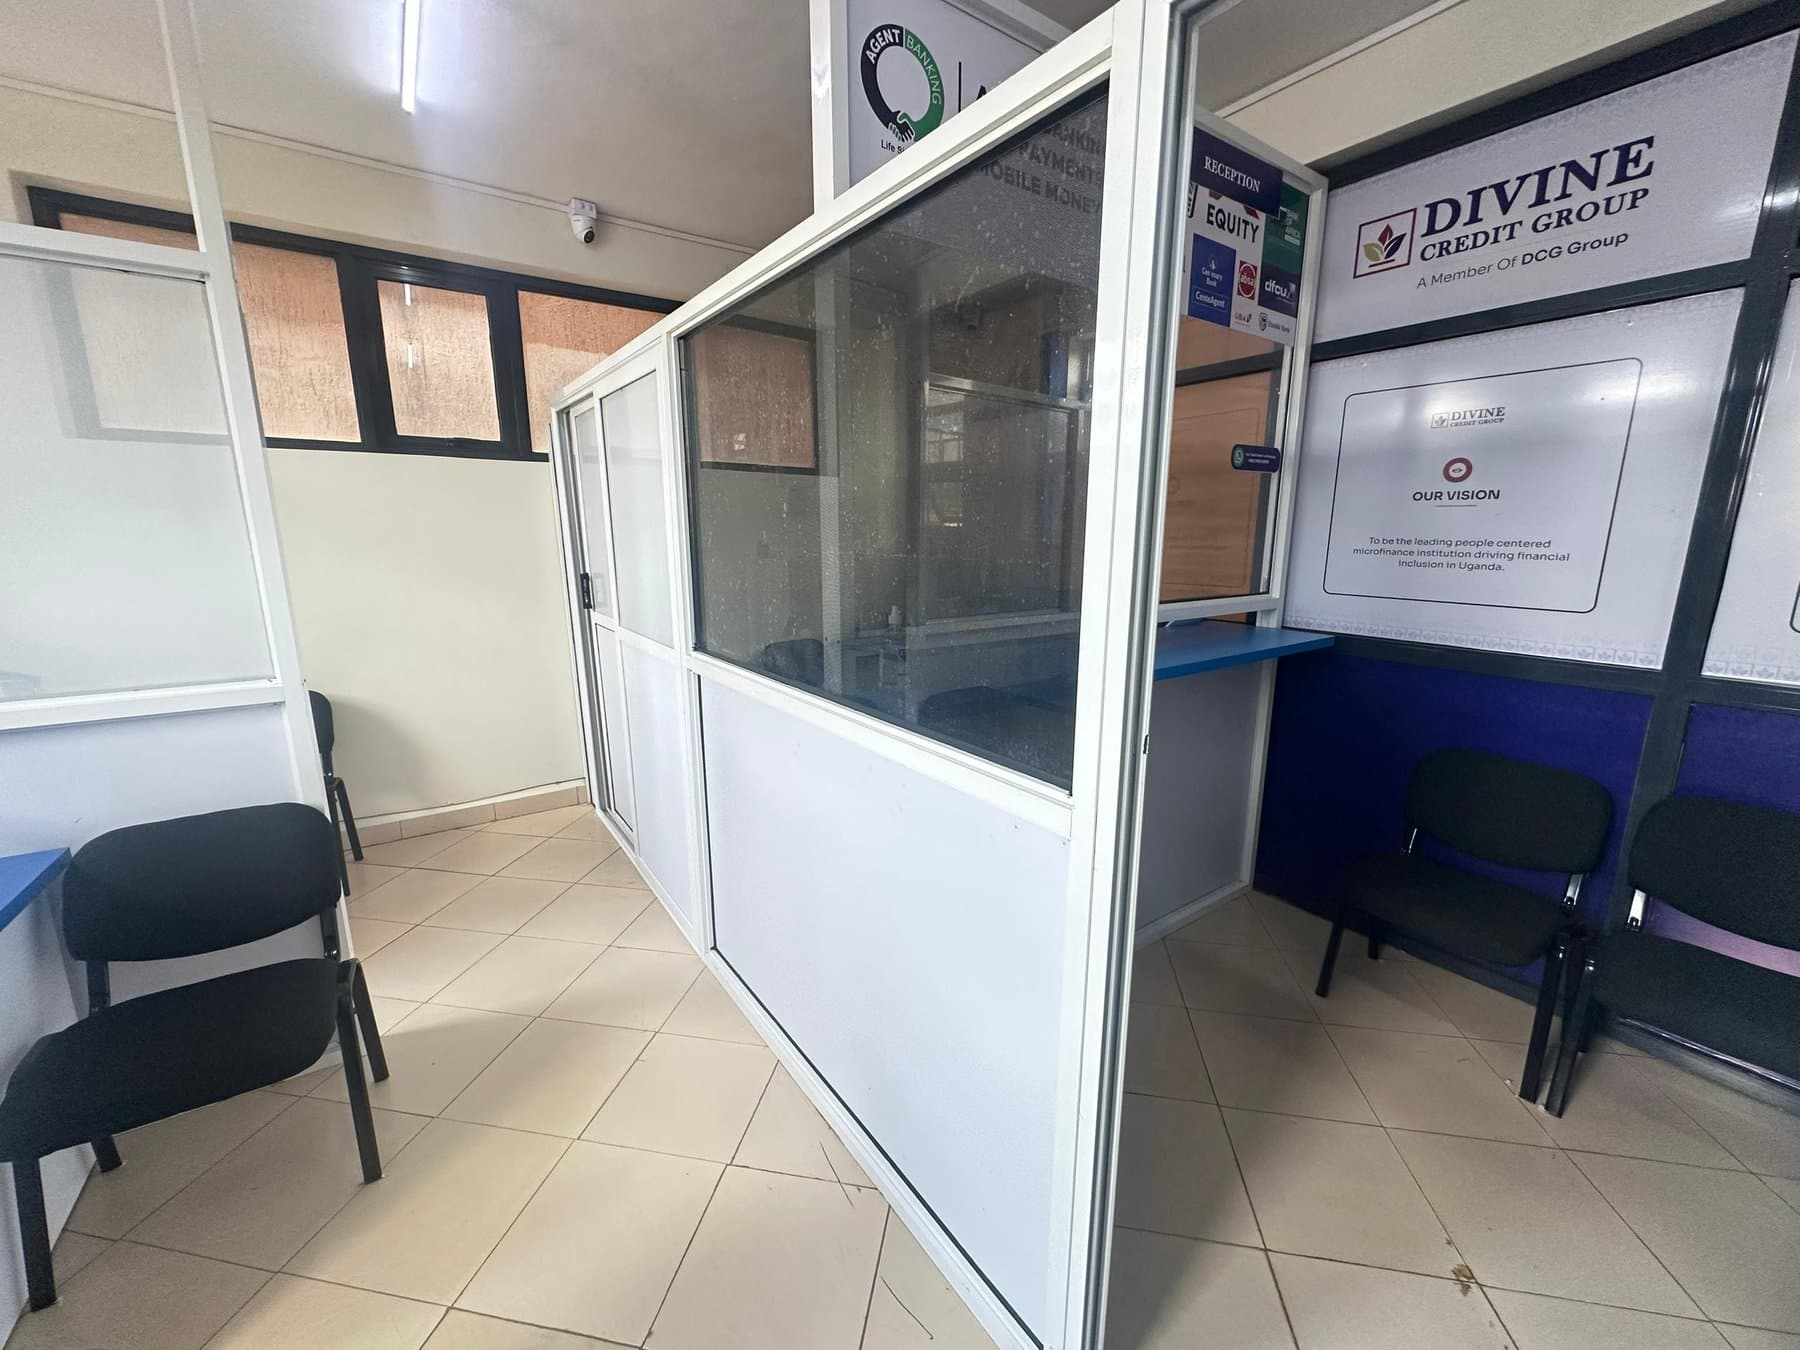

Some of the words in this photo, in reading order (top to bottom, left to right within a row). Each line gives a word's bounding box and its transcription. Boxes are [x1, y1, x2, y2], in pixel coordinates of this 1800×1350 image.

[865, 28, 901, 65] AGENT
[906, 35, 943, 106] BANKING
[881, 139, 896, 153] Life
[1203, 155, 1261, 192] RECEPTION
[1420, 135, 1655, 238] DIVINE
[1206, 203, 1260, 244] EQUITY
[1420, 220, 1523, 262] CREDIT
[1531, 187, 1650, 234] GROUP
[1416, 277, 1427, 289] A
[1430, 263, 1494, 287] Member
[1496, 256, 1518, 271] Of
[1521, 245, 1563, 266] DCG
[1567, 231, 1629, 255] Group
[1264, 279, 1288, 298] dfcu
[1451, 406, 1506, 421] DIVINE
[1449, 420, 1477, 428] CREDIT
[1478, 417, 1505, 425] GROUP
[1412, 491, 1444, 502] OUR
[1446, 489, 1502, 501] VISION
[1369, 536, 1380, 545] To
[1382, 537, 1394, 546] be
[1396, 537, 1412, 546] the
[1414, 537, 1452, 548] leading
[1454, 538, 1495, 550] people
[1496, 539, 1552, 549] centered
[1352, 547, 1415, 557] microfinance
[1417, 549, 1471, 559] institution
[1473, 550, 1515, 562] driving
[1516, 551, 1571, 562] financial
[1398, 560, 1445, 570] inclusion
[1446, 561, 1456, 569] in
[1458, 561, 1506, 572] Uganda.
